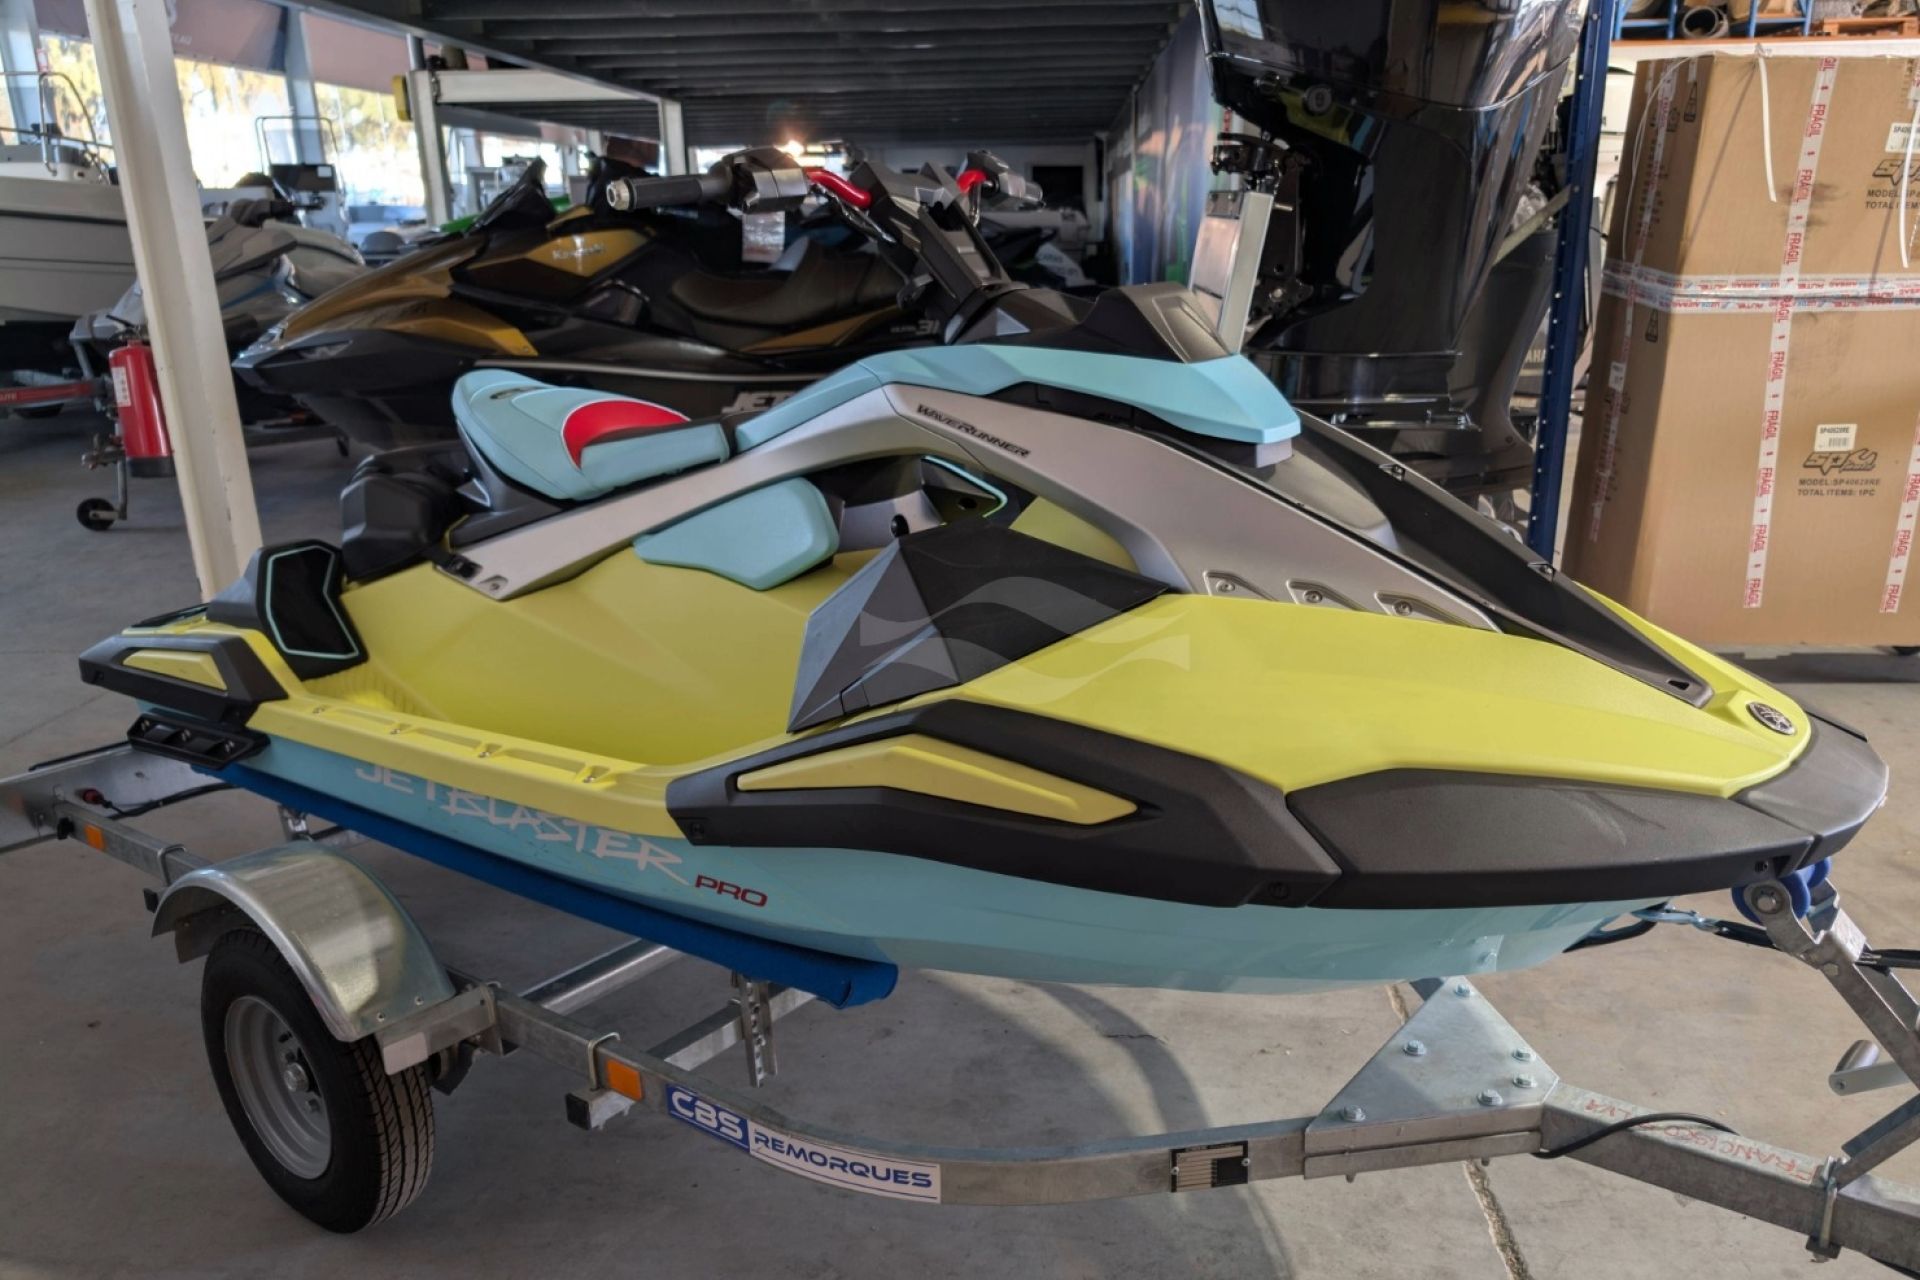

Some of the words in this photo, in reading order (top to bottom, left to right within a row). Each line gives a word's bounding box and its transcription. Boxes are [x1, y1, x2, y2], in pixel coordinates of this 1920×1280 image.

[1810, 104, 1826, 137] FRAGIL
[1797, 169, 1813, 201] FRAGIL
[1787, 232, 1803, 265] FRAGIL
[1770, 352, 1786, 382] FRAGIL
[1765, 410, 1780, 440] FRAGIL
[1759, 468, 1773, 497] FRAGIL
[1797, 488, 1824, 497] TOTAL
[1754, 525, 1768, 552] FRAGIL
[1747, 579, 1762, 607] FRAGIL
[695, 874, 767, 908] PRO
[671, 1090, 743, 1141] CBS
[753, 1129, 932, 1188] REMORQUES
